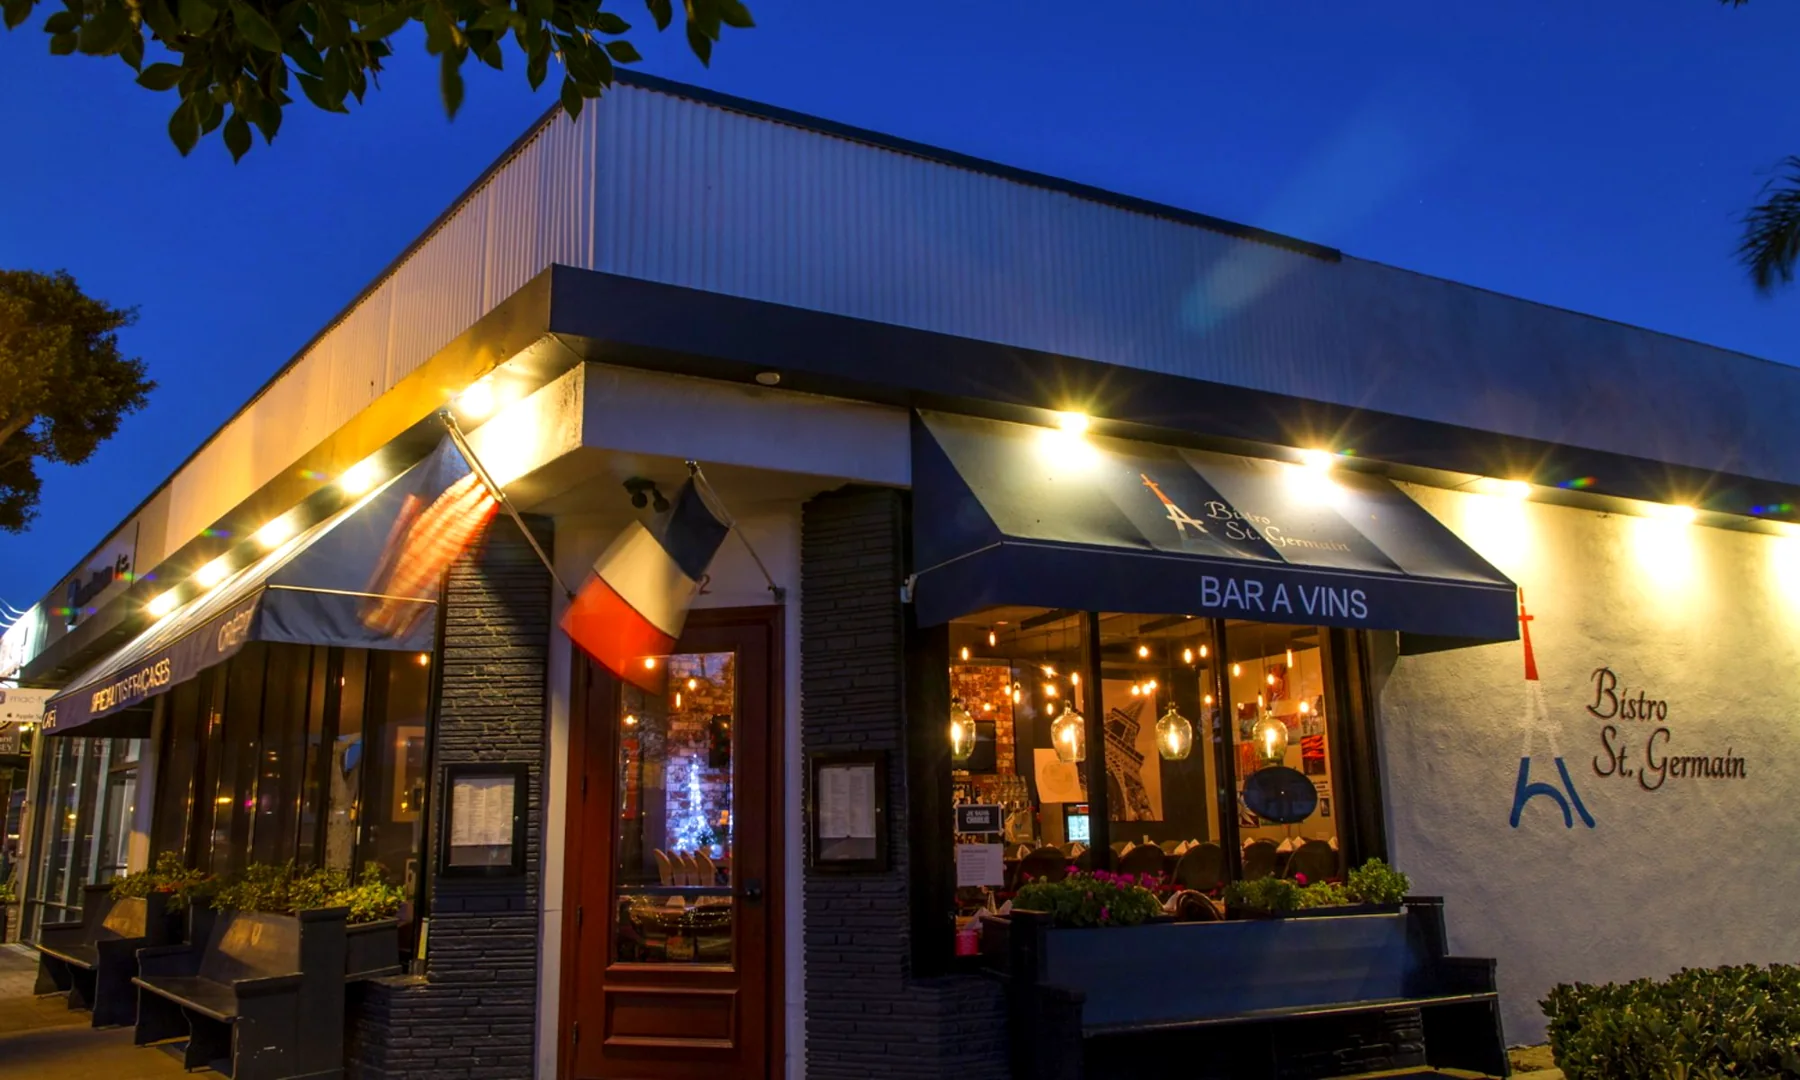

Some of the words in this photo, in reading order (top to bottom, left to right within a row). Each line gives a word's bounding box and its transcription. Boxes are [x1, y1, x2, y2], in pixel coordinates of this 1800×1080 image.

[1225, 521, 1260, 541] St.
[1263, 526, 1350, 552] Germain
[1201, 575, 1265, 612] BAR
[1272, 583, 1293, 614] A
[1298, 585, 1368, 619] VINS
[1586, 666, 1668, 722] Bistro
[1592, 725, 1633, 778] St.
[1639, 727, 1747, 791] Germain
